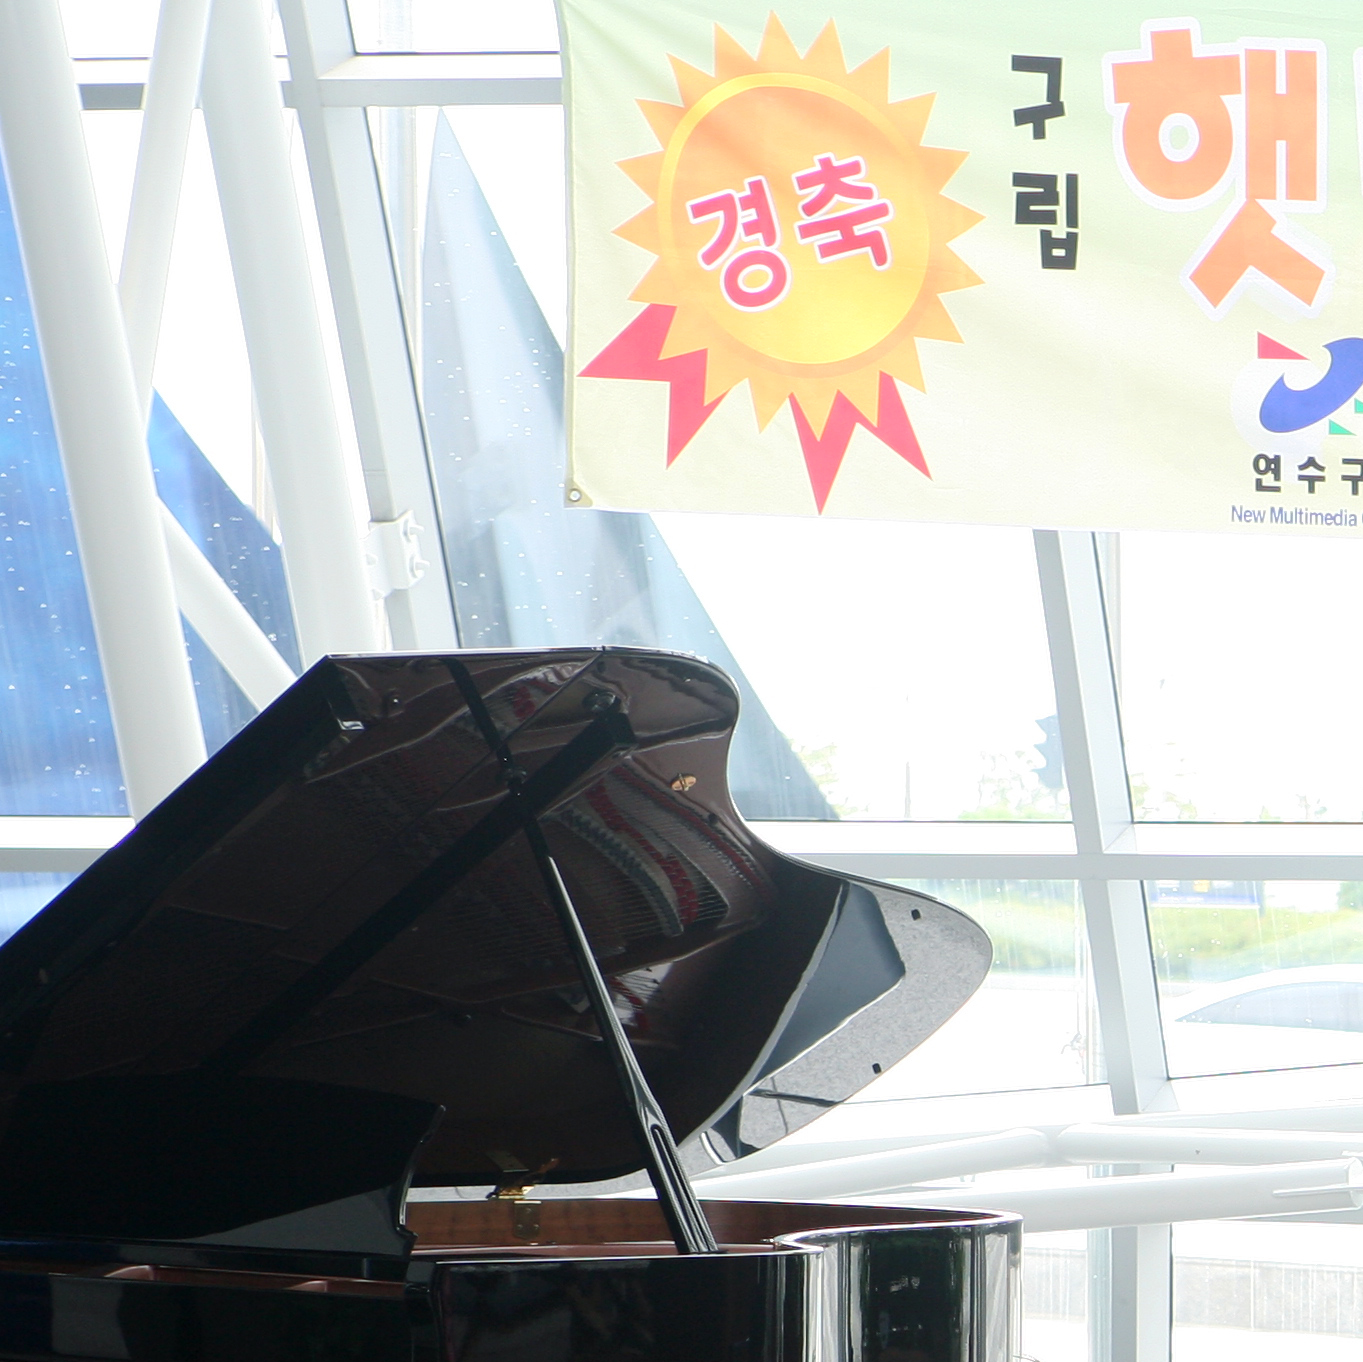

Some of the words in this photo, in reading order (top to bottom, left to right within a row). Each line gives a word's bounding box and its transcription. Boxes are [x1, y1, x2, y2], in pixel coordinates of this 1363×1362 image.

[689, 156, 890, 308] 경축
[1010, 55, 1079, 271] 구립
[1231, 504, 1266, 523] New
[1270, 506, 1358, 527] Multimedia
